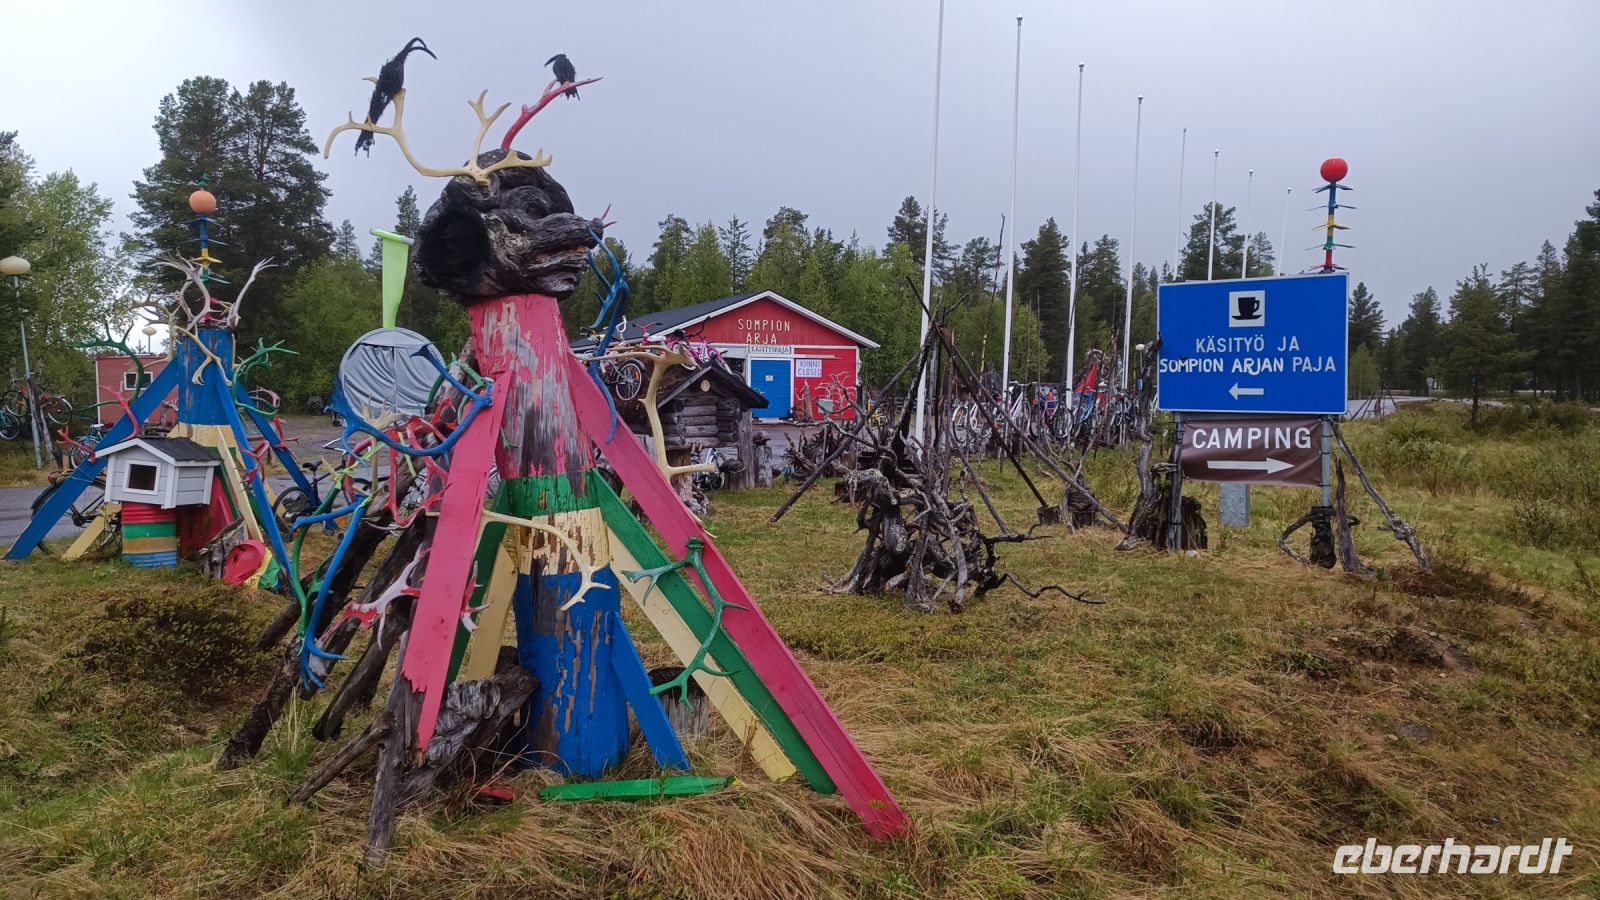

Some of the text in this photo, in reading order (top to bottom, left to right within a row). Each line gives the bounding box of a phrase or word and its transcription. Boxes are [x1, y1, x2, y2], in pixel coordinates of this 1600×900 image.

[738, 318, 790, 332] SOMPION
[746, 332, 776, 344] ARJA
[1196, 335, 1300, 353] KÄSITYÖ JA
[1159, 356, 1336, 376] SOMPION ARJAN PAJA
[1192, 427, 1311, 449] CAMPING
